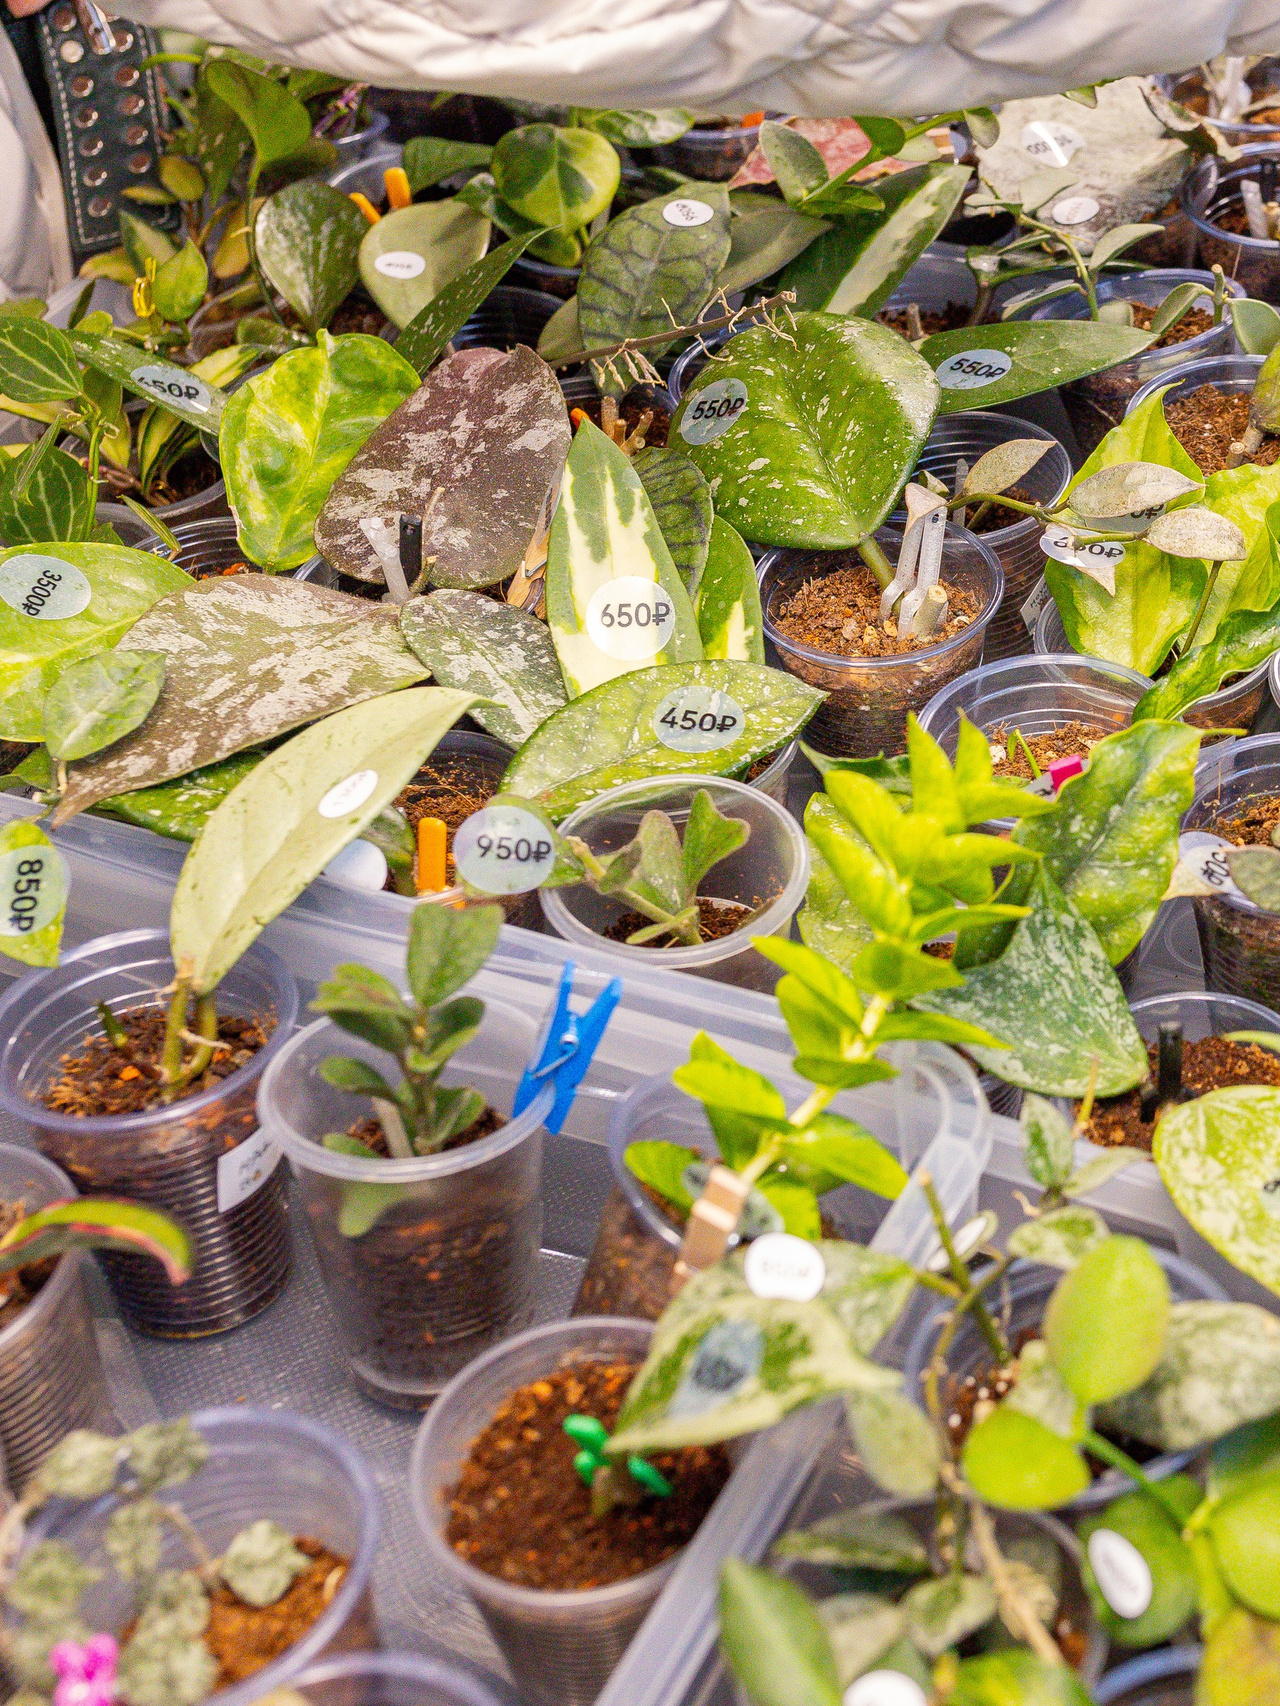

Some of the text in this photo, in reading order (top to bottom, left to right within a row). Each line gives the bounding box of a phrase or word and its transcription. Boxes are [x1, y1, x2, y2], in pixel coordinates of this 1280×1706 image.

[950, 357, 1007, 379] 550₽
[692, 397, 745, 420] 550₽
[22, 570, 62, 617] 3500₽
[600, 601, 671, 629] 650₽
[659, 707, 738, 733] 450₽
[477, 834, 552, 863] 950₽
[9, 858, 43, 932] 850₽
